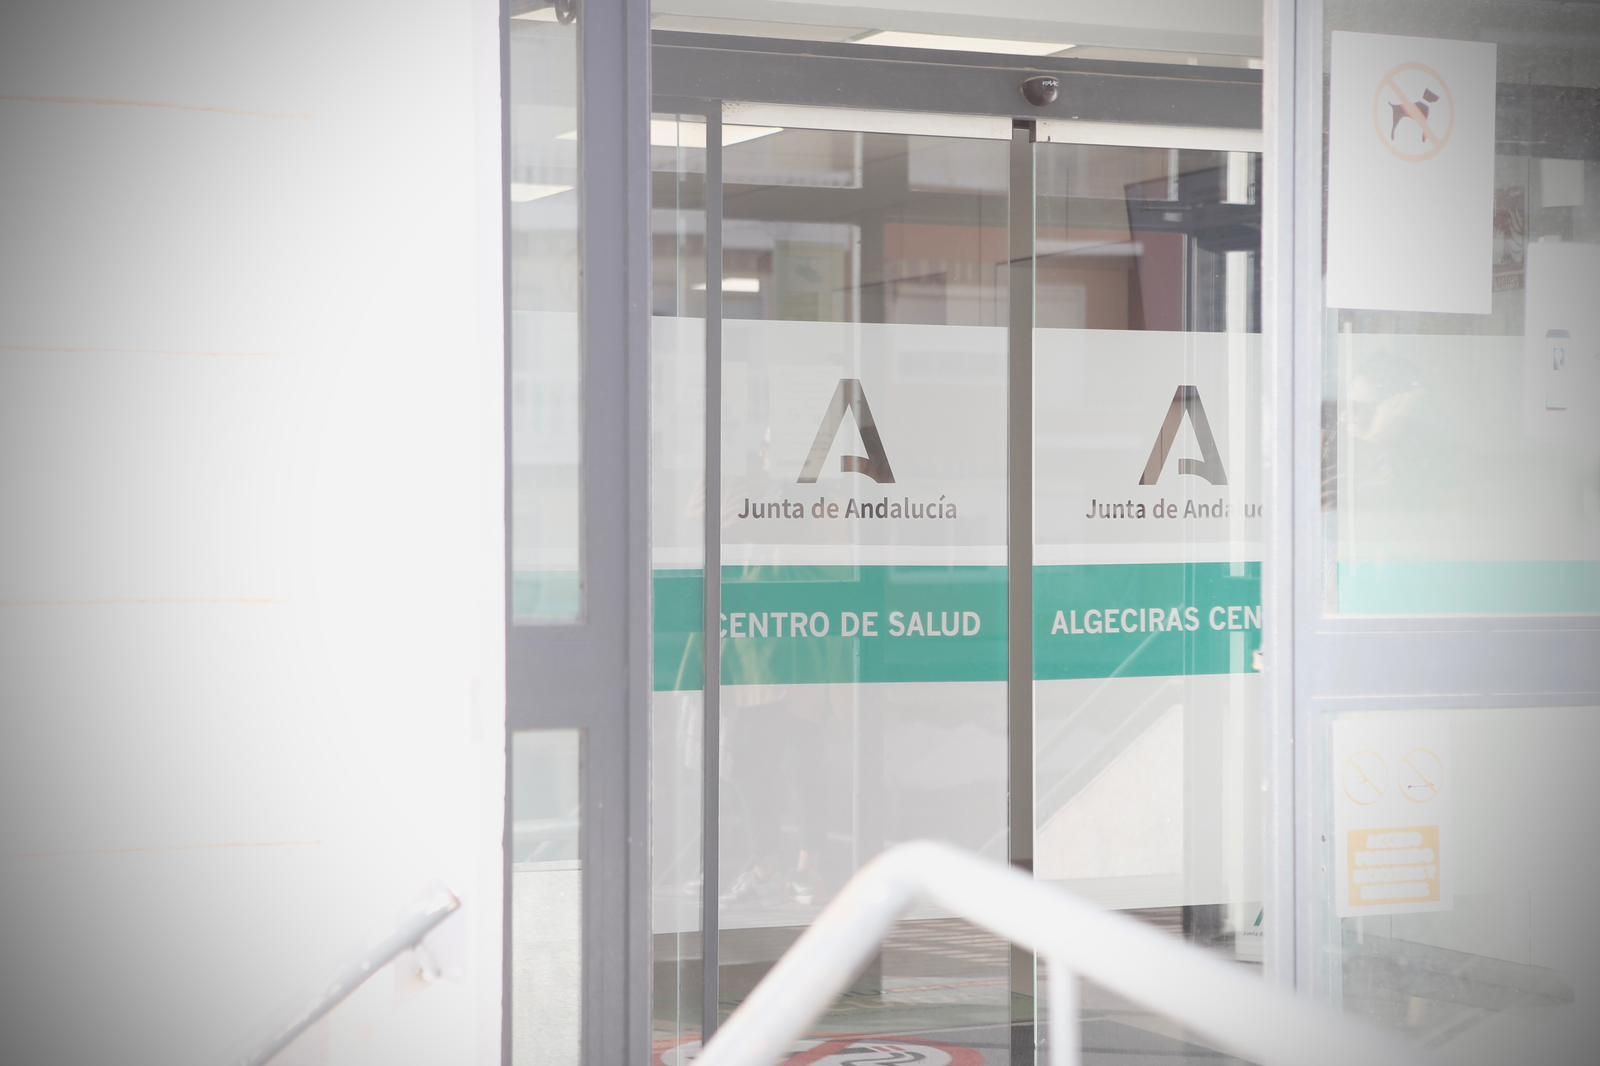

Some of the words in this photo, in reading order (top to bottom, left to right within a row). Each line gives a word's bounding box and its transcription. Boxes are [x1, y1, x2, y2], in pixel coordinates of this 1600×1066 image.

[738, 498, 804, 519] Junta
[811, 497, 839, 519] de
[845, 494, 957, 519] Andalucía
[1086, 499, 1146, 519] Junta
[1152, 498, 1178, 519] de
[841, 611, 879, 637] DE
[888, 611, 981, 637] SALUD
[1051, 607, 1199, 635] ALGECIRAS
